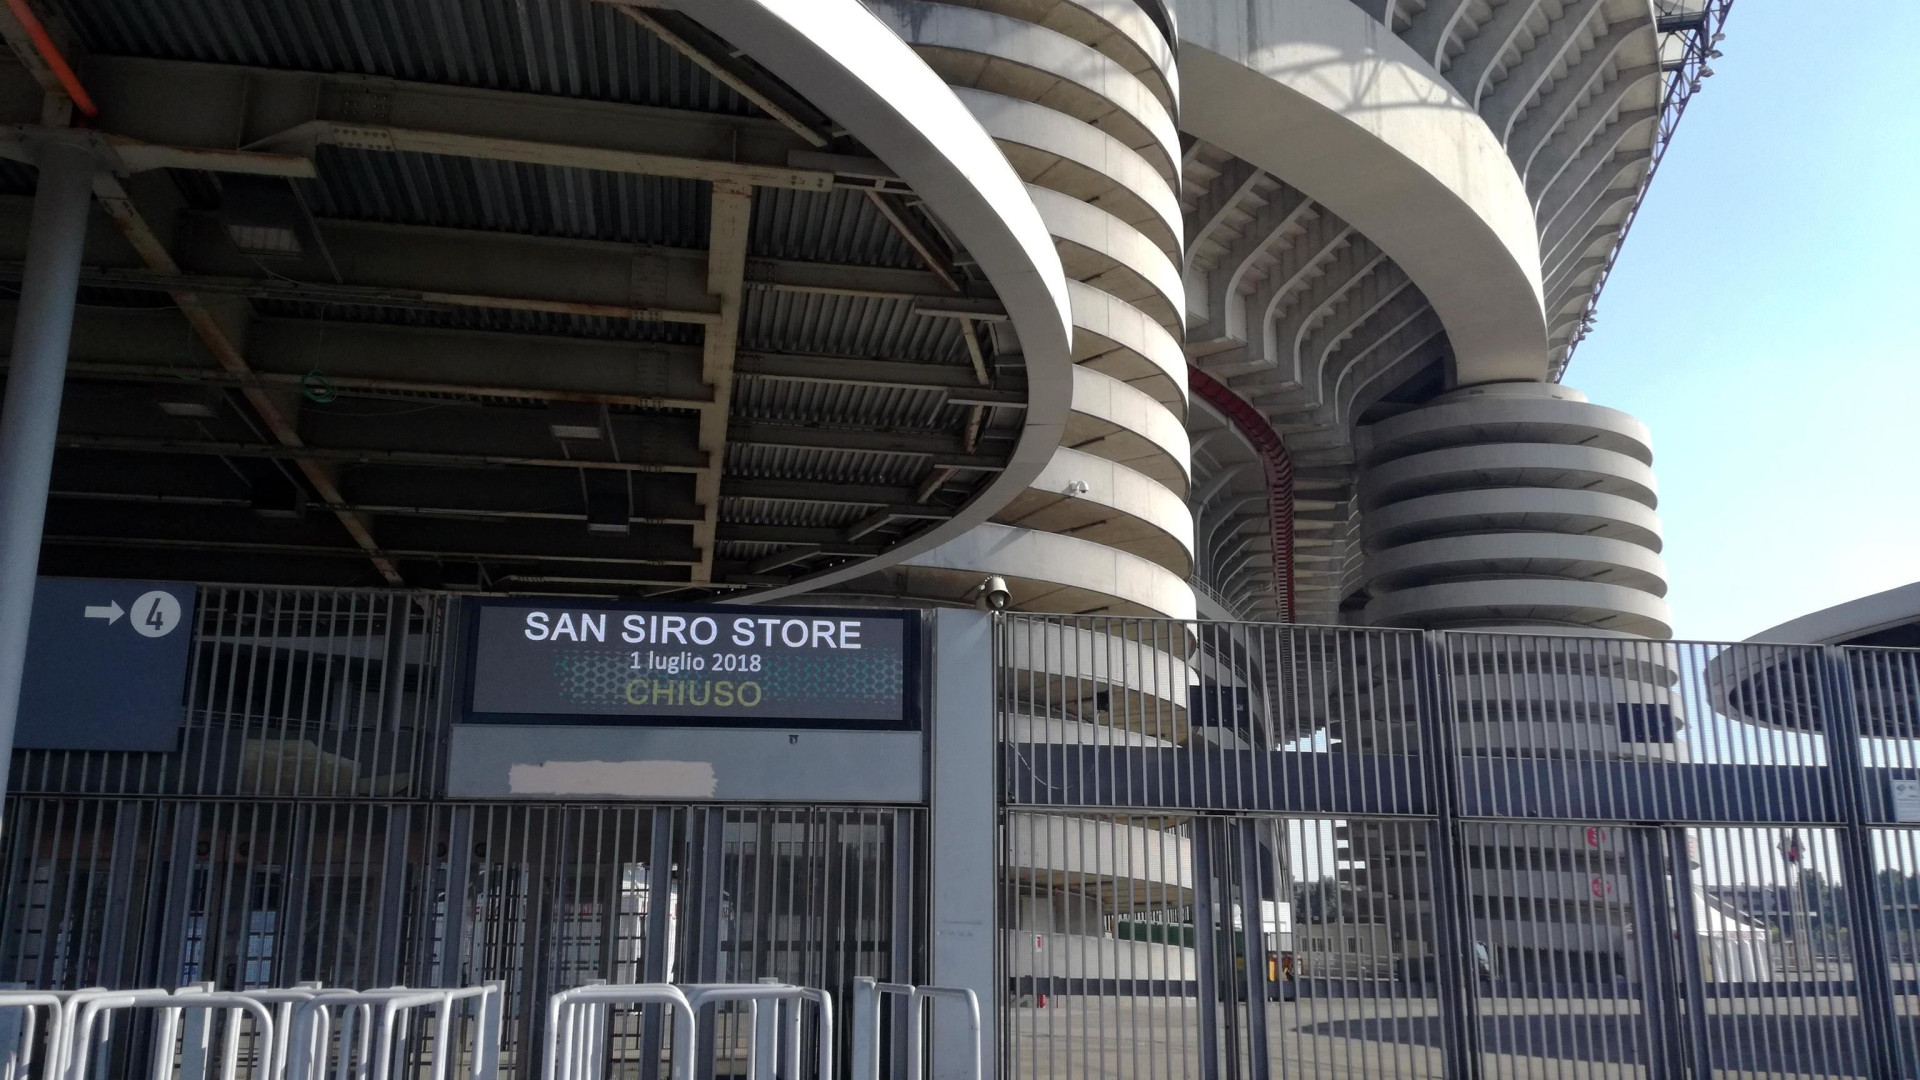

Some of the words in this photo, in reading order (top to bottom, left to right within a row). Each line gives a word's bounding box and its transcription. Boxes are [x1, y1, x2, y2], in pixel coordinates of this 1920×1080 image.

[145, 597, 164, 631] 4
[524, 611, 606, 643] SAN
[621, 614, 718, 646] SIRO
[731, 617, 862, 649] STORE
[629, 651, 641, 669] 1
[649, 650, 705, 674] luglio
[711, 653, 762, 672] 2018
[625, 678, 762, 707] CHIUSO
